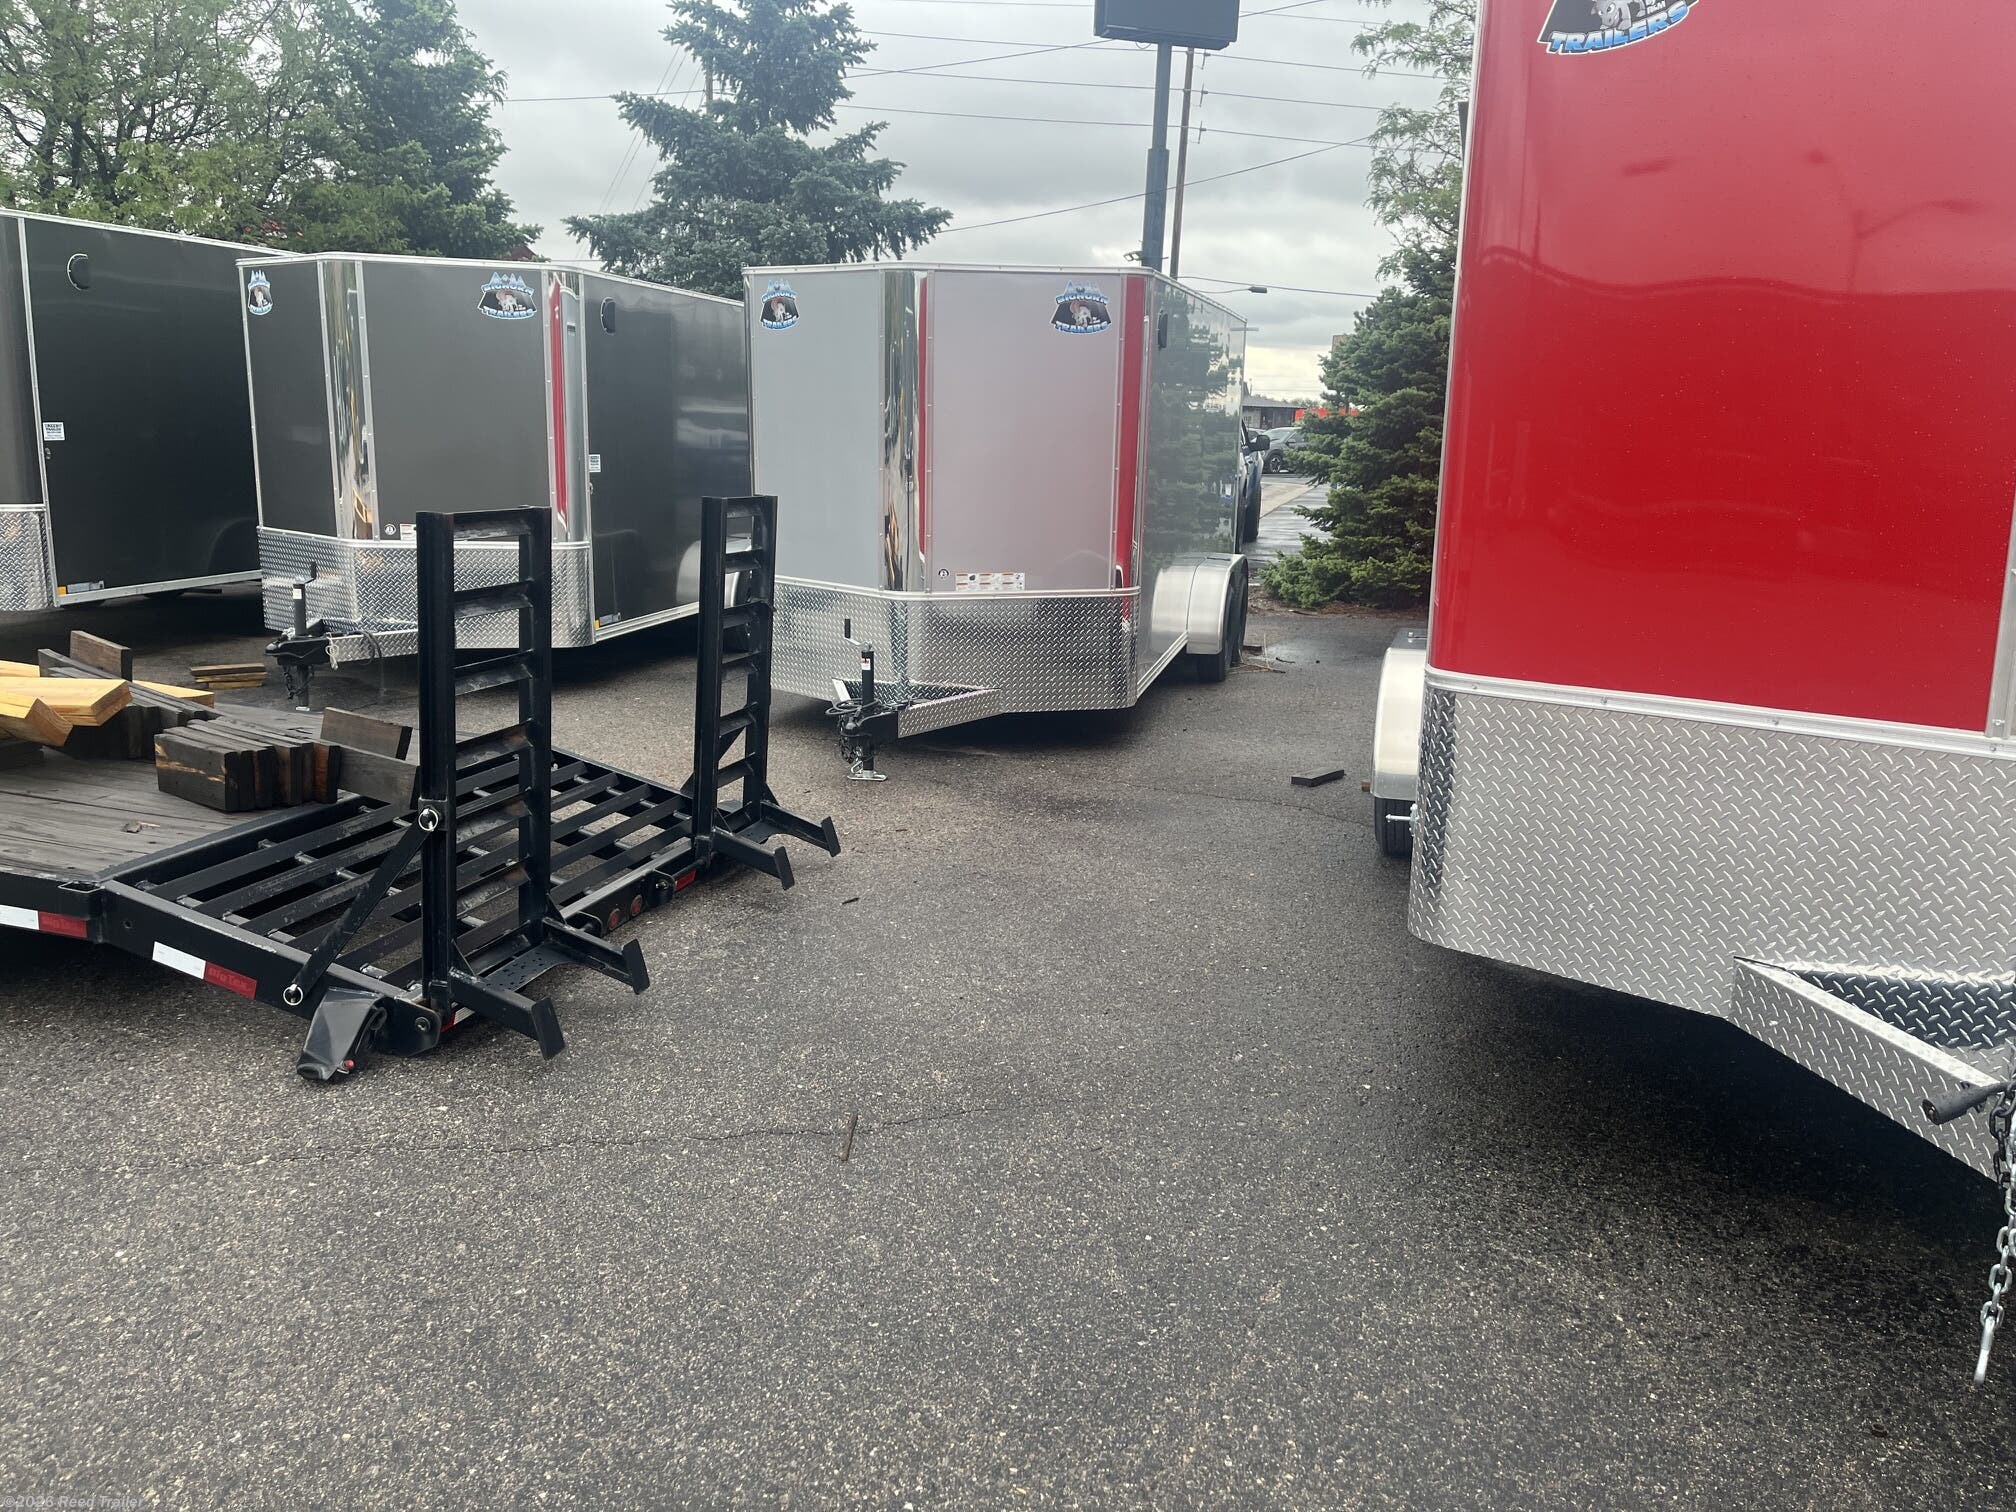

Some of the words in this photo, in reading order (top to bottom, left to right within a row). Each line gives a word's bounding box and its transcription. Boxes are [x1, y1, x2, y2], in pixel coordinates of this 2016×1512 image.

[1550, 0, 1688, 52] TRAILERS
[1056, 292, 1110, 304] BIGHORN
[482, 305, 536, 319] TRAILERS
[761, 315, 798, 329] TRAILERS
[1055, 320, 1109, 333] TRAILERS
